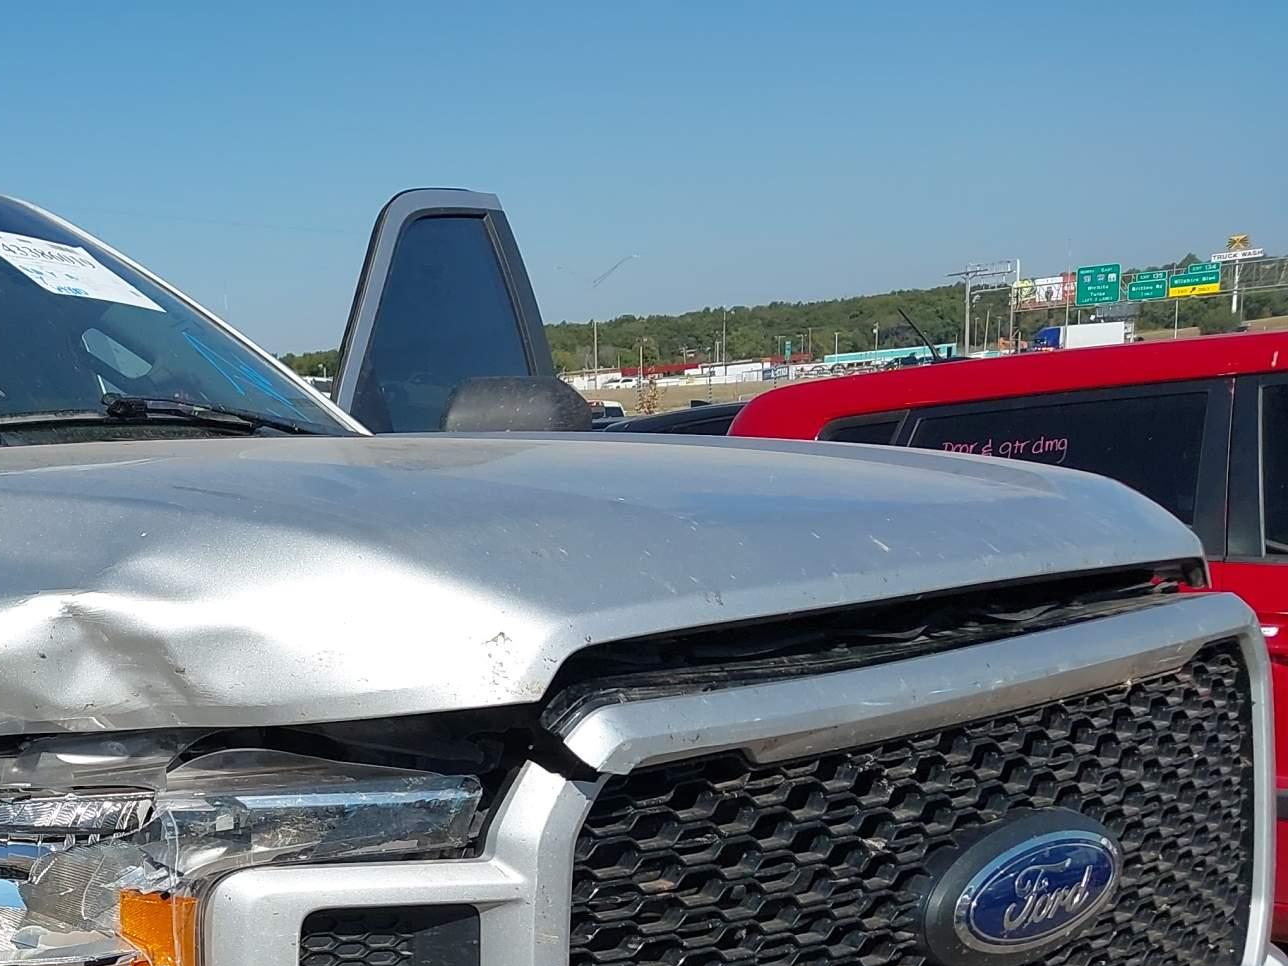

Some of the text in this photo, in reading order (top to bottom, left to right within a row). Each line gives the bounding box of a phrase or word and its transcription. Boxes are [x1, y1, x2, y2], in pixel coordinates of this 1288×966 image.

[1213, 249, 1263, 261] TRUCK WASH
[1032, 436, 1068, 464] dmg
[1003, 857, 1093, 931] Ford
